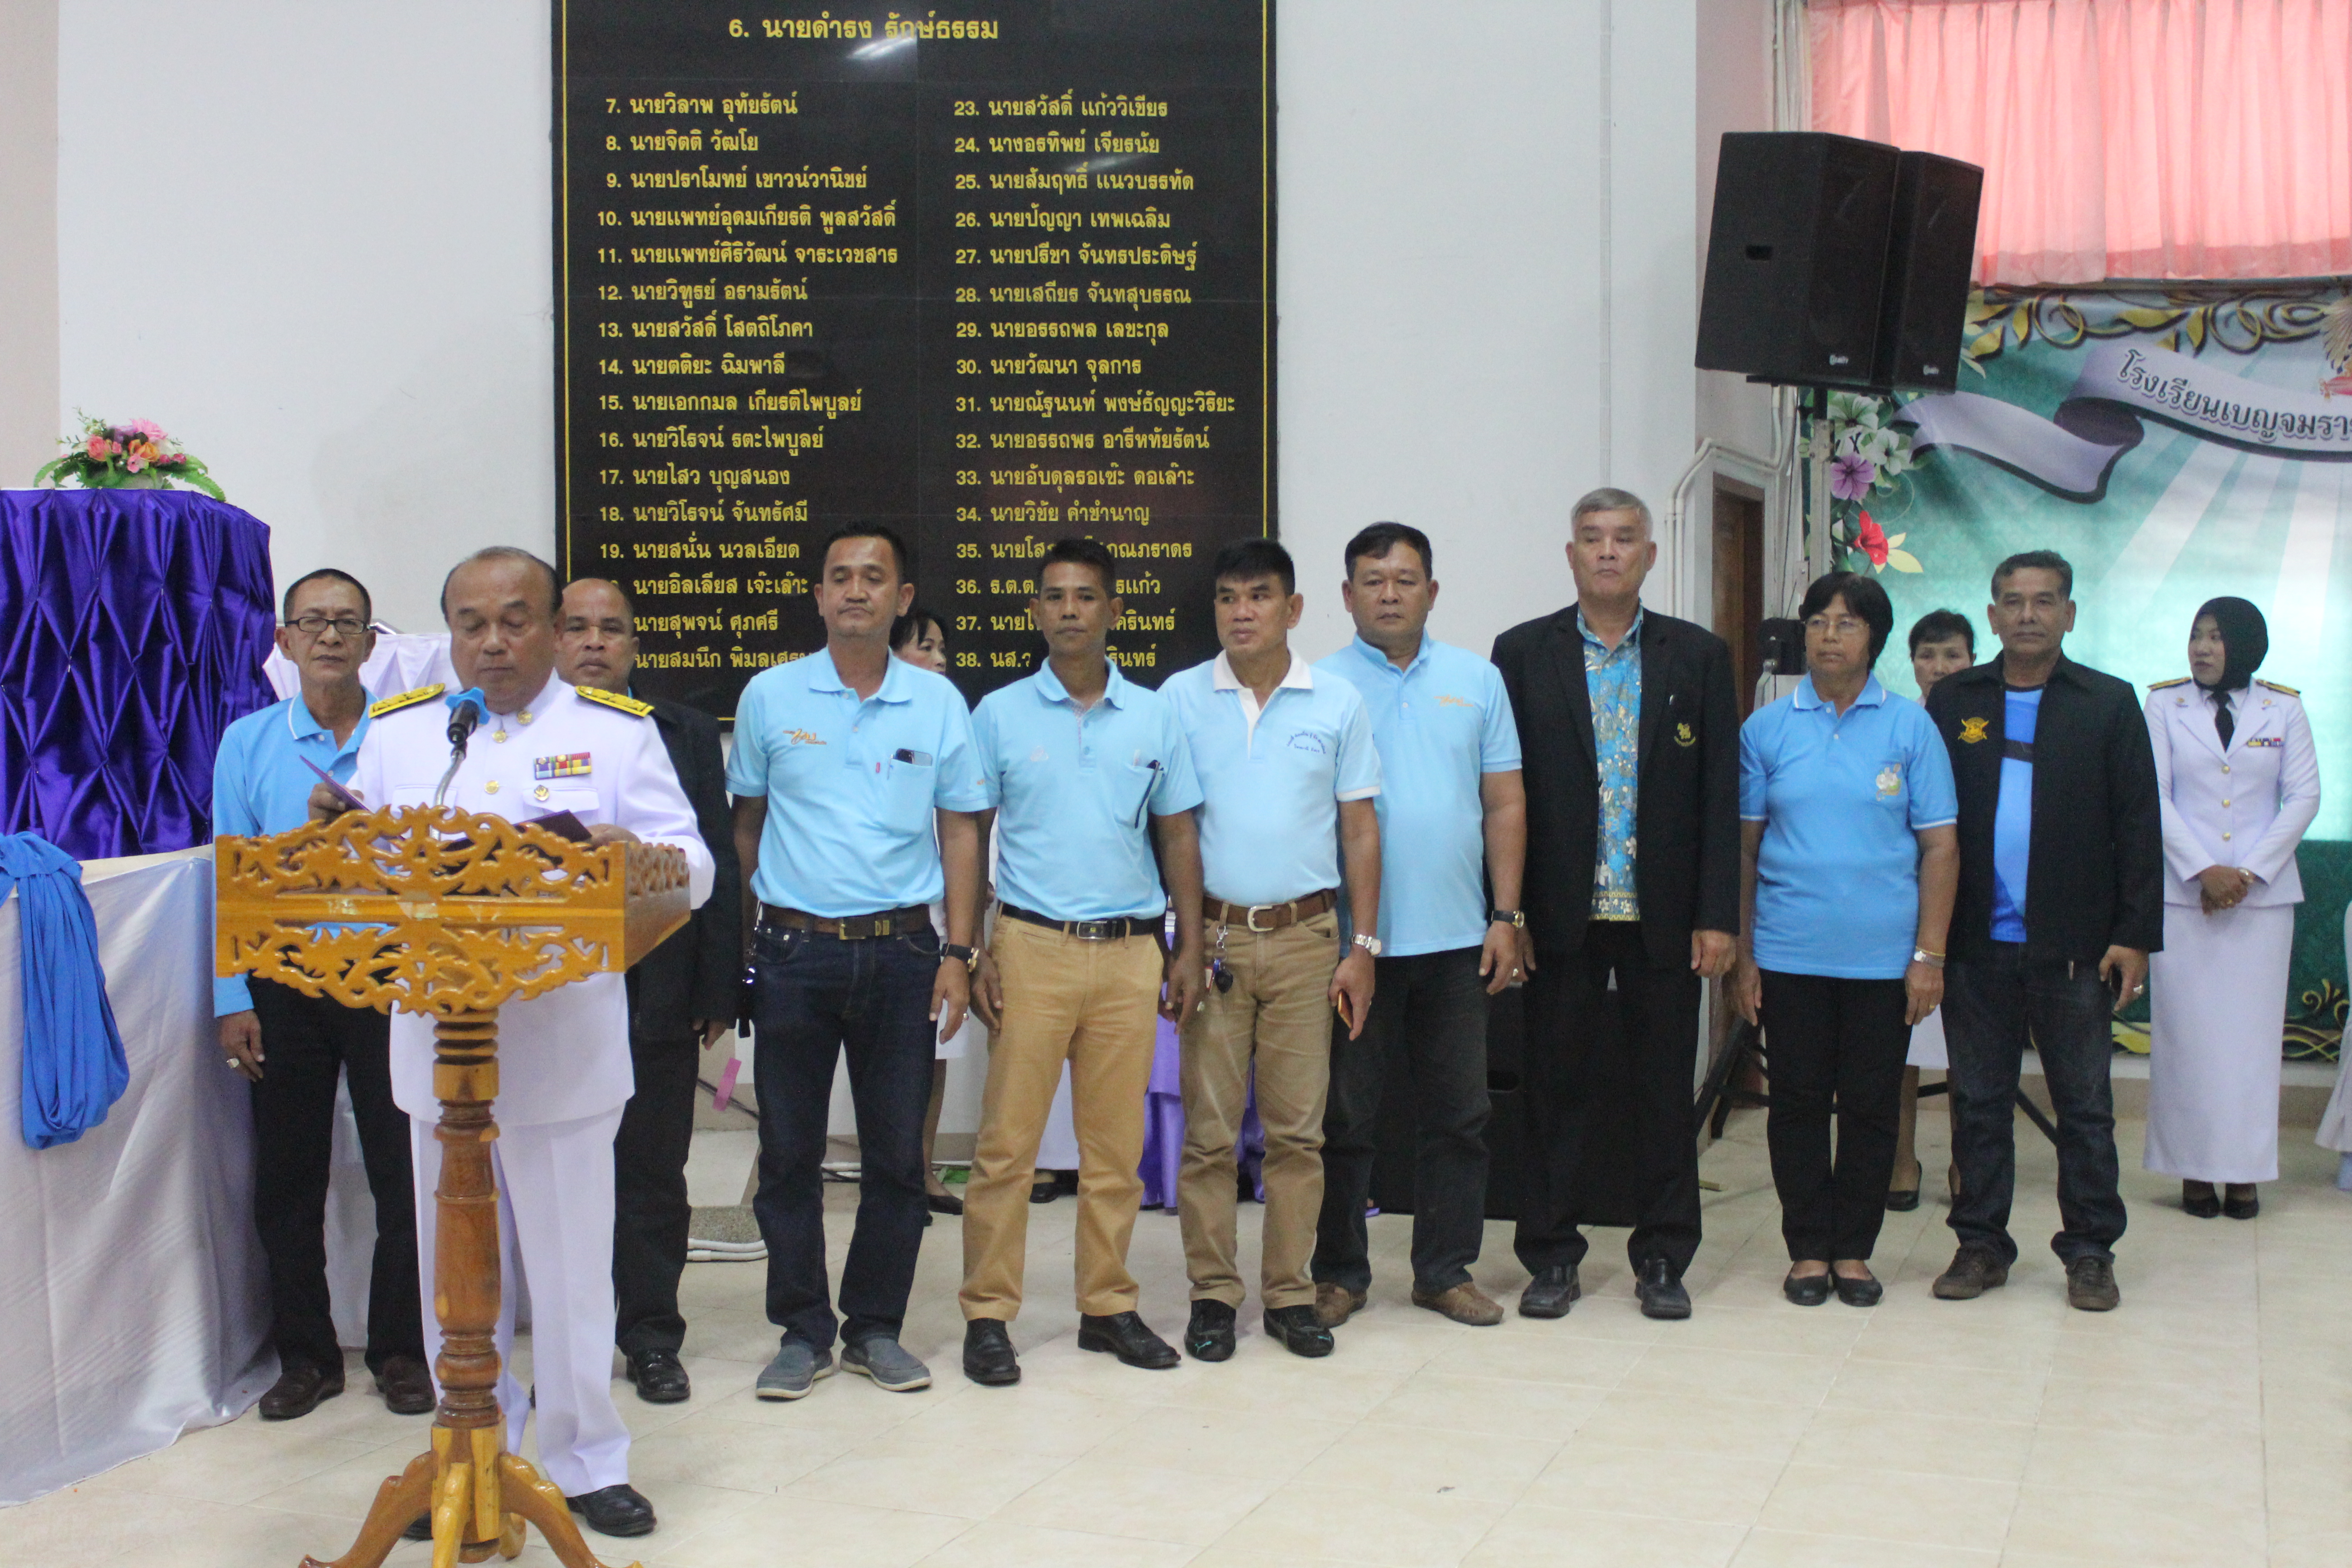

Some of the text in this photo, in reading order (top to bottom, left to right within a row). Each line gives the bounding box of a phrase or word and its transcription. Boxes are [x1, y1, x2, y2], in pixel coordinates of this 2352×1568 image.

[729, 10, 998, 39] 6. นายดำรง รักษ์ธรรม
[606, 98, 621, 113] 7.
[722, 91, 798, 122] อุทัยรัตน์
[954, 101, 980, 116] 23.
[988, 88, 1073, 115] นายสวัสดิ์
[606, 136, 621, 150] 8.
[630, 128, 702, 151] นายจิตติ
[955, 128, 1159, 153] 24. นางอรทิพย์ เจียรนัย
[606, 173, 622, 187] 9.
[630, 165, 747, 188] นายปราโมทย์
[955, 162, 1194, 194] 25. นายสัมฤทธิ์ แนวบรรทัด
[598, 199, 896, 234] 10. นายแพทย์อุดมเกียรติ พูลสวัสดิ์
[956, 203, 1170, 232] 26. นายปัญญา เทพเฉลิม
[598, 248, 622, 263] 11.
[631, 240, 787, 263] นายแพทย์ศิริวัฒน์
[956, 249, 981, 264] 27.
[598, 285, 622, 300] 12.
[956, 288, 981, 302] 28.
[990, 280, 1078, 302] นายเสถียร
[598, 323, 623, 337] 13.
[632, 310, 717, 337] นายสวัสดิ์
[956, 322, 981, 337] 29.
[990, 322, 1097, 337] นายอรรถพล
[599, 359, 623, 374] 14.
[721, 352, 785, 374] ฉิมพาลี
[956, 353, 1141, 382] 30. นายวัฒนา จุลการ
[599, 388, 862, 419] 15. นายเอกกมล เกียรติไพบูลย์
[956, 397, 981, 412] 31.
[990, 389, 1096, 417] นายณัฐนนท์
[2119, 348, 2352, 438] โรงเรียนเบญจมรา
[600, 432, 624, 447] 16.
[632, 425, 724, 447] นายวิโรจน์
[956, 434, 981, 448] 32.
[990, 433, 1094, 448] นายอรรถพร
[600, 462, 790, 493] 17. นายไสว บุญสนอง
[956, 470, 981, 485] 33.
[600, 499, 807, 521] 18. นายวิโรจน์ จันทรัศมี
[956, 507, 981, 522] 34.
[600, 531, 799, 558] 19. นายสนั่น นวลเอียด
[956, 544, 981, 558] 35.
[956, 579, 981, 594] 36.
[633, 608, 778, 639] นายสุพจน์ ศุภศรี
[956, 616, 981, 630] 37.
[956, 652, 981, 667] 38.
